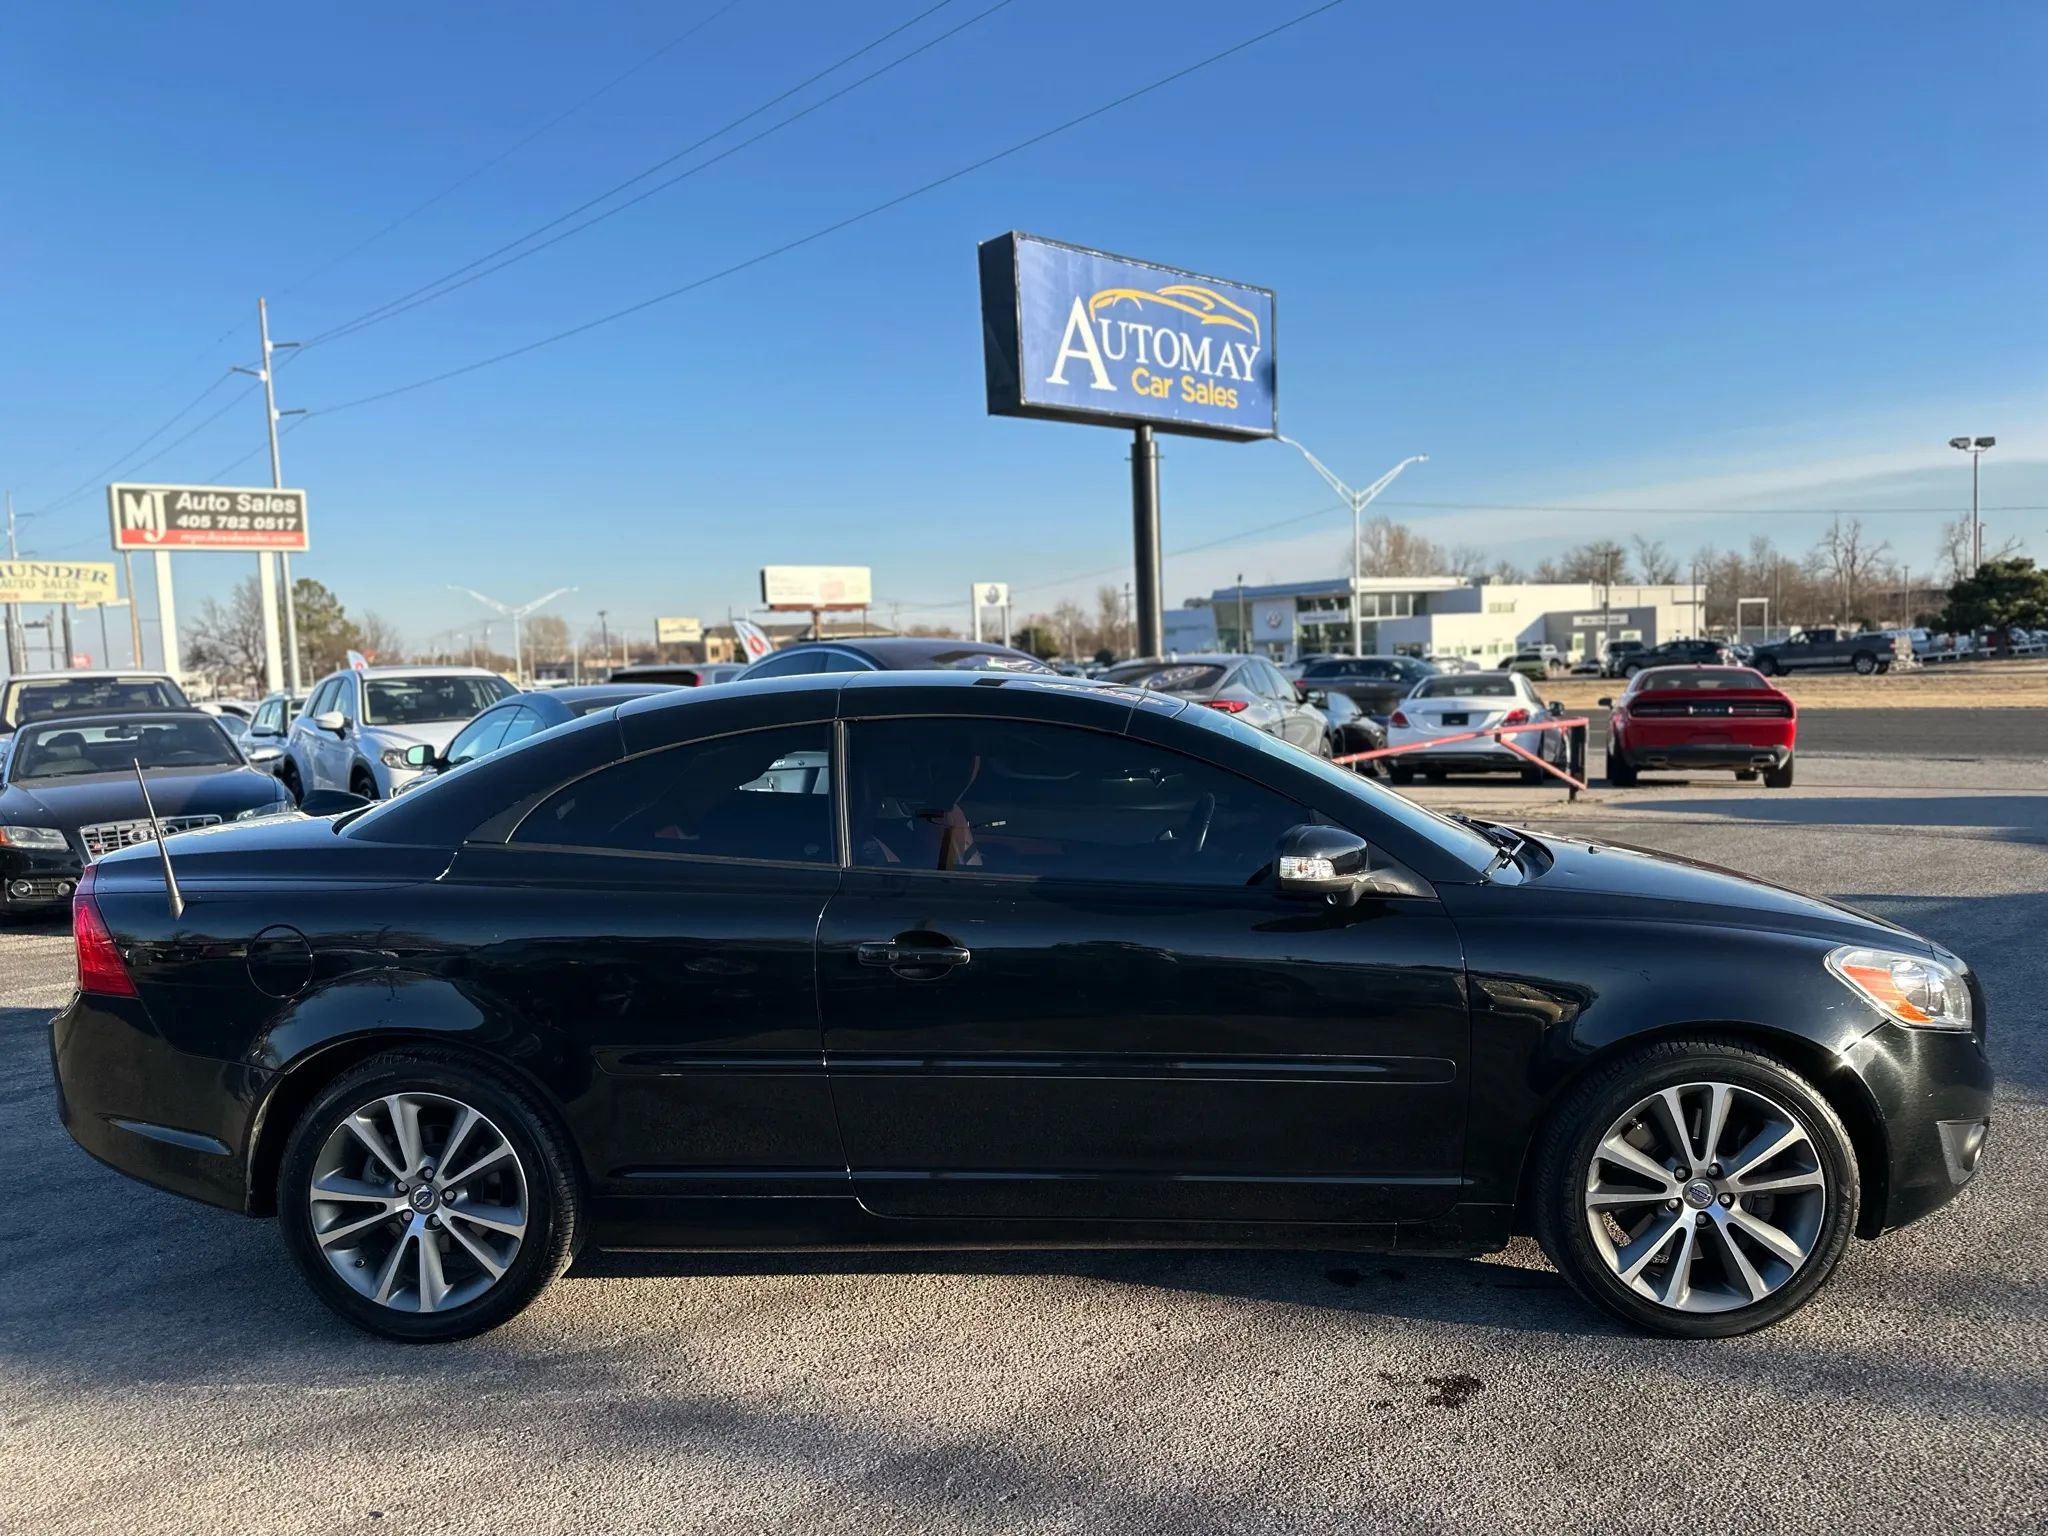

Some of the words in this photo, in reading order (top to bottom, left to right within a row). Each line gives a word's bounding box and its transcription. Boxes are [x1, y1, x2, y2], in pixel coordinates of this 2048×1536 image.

[1046, 296, 1260, 391] AUTOMAY
[1131, 367, 1173, 399] Car
[1181, 376, 1238, 409] Sales
[175, 492, 231, 511] Auto
[236, 494, 297, 513] Sales
[123, 490, 170, 543] MJ
[176, 514, 212, 528] 405
[217, 515, 250, 529] 782
[253, 516, 297, 530] 0517
[0, 563, 109, 586] UNDER
[0, 579, 36, 589] AUTO
[41, 580, 80, 589] SALES
